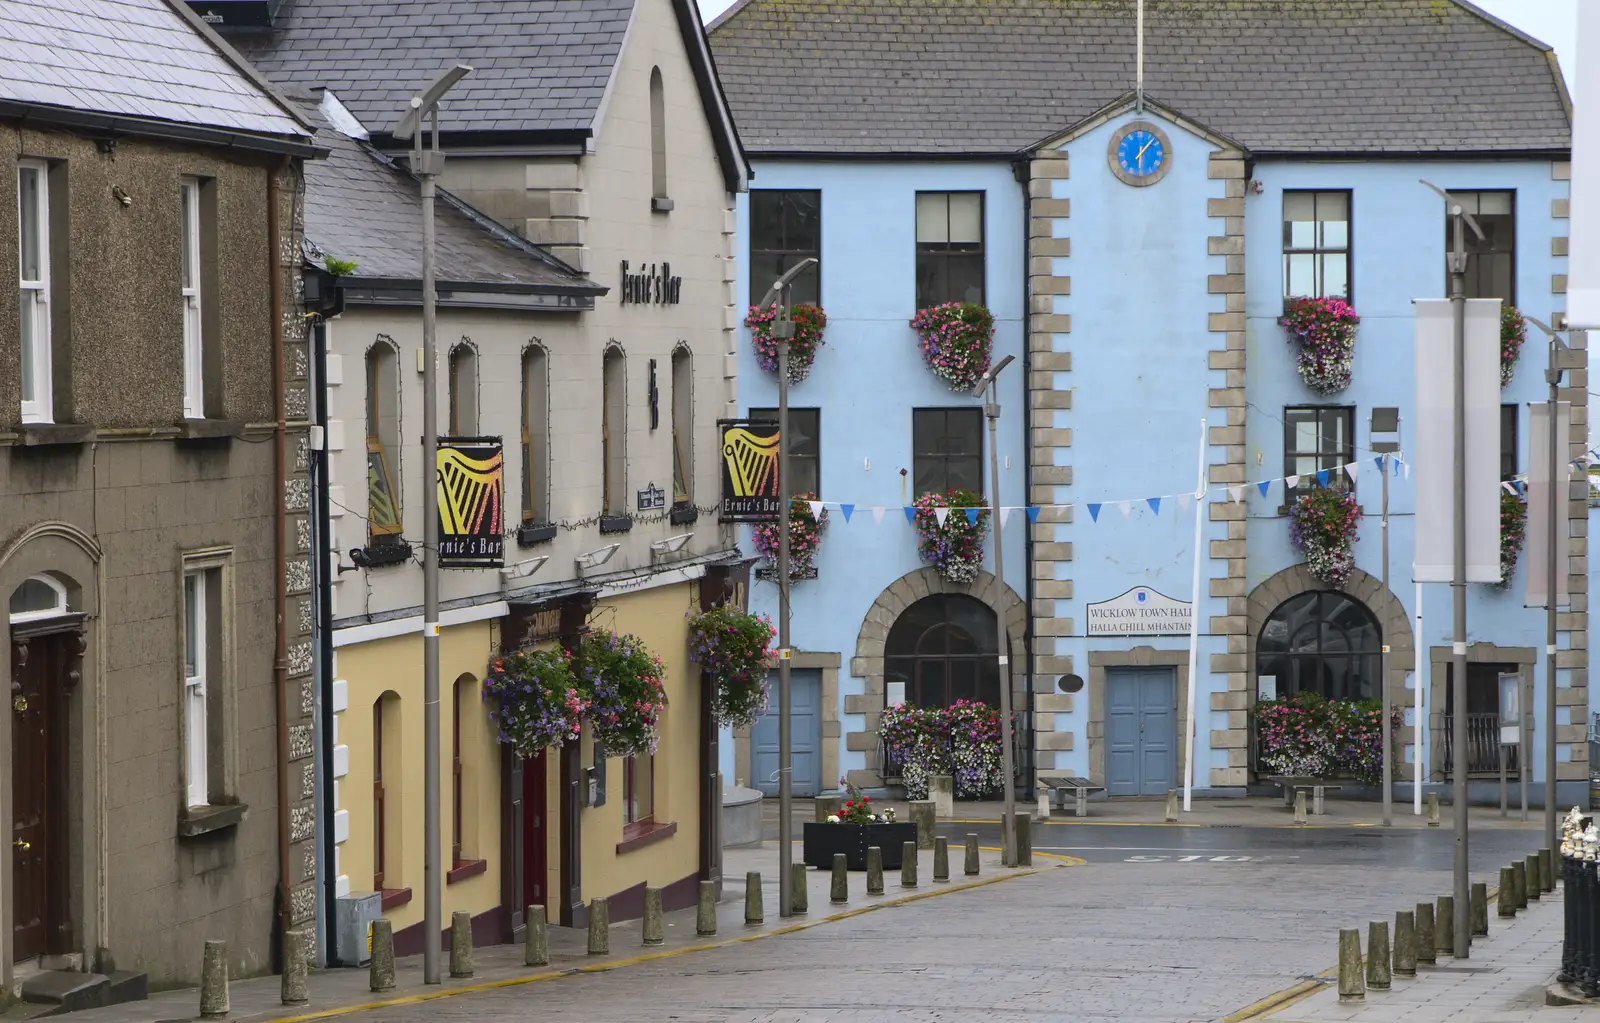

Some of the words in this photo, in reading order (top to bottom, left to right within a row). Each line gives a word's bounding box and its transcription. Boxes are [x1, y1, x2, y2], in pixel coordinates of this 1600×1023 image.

[621, 260, 661, 304] Ernie's
[662, 262, 682, 304] Bar
[724, 498, 760, 511] Ernie's
[763, 498, 780, 511] Bar
[439, 537, 476, 554] rnie's
[479, 537, 501, 554] Bar
[1090, 608, 1137, 618] WICKLOW
[1139, 608, 1168, 618] TOWN
[1090, 623, 1117, 632] HALLA
[1119, 622, 1145, 632] CHILL
